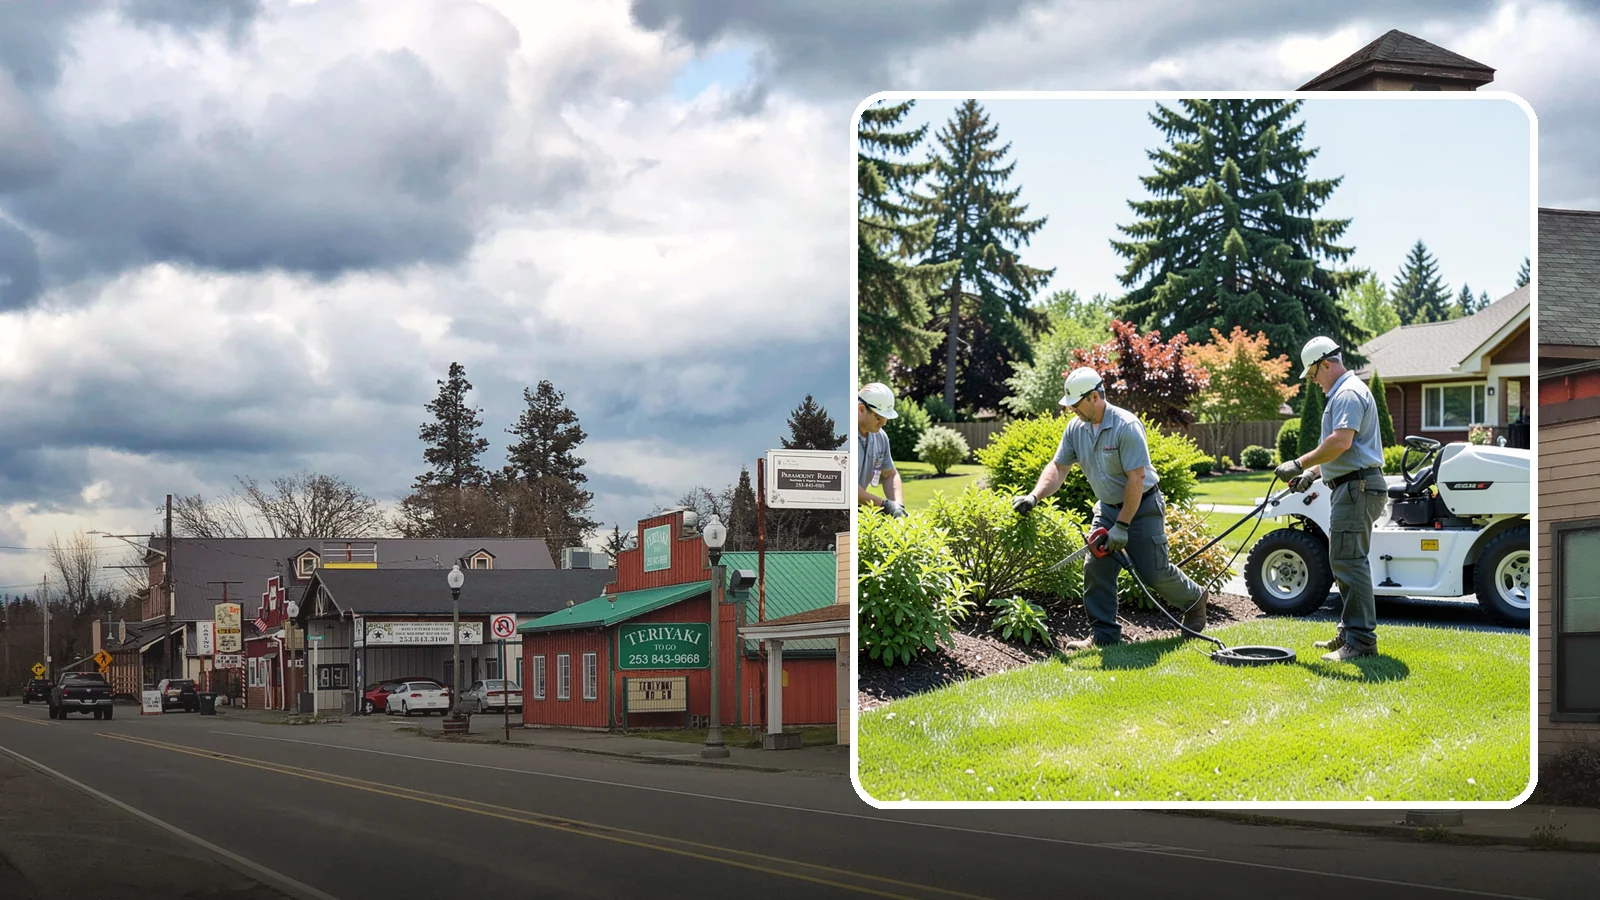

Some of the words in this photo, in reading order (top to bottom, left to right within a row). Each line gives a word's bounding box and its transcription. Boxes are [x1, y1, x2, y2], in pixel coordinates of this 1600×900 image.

[781, 471, 815, 479] PARAMOUNT
[625, 627, 702, 645] TERIYAKI
[629, 654, 648, 664] 253
[651, 654, 700, 664] 843-9668
